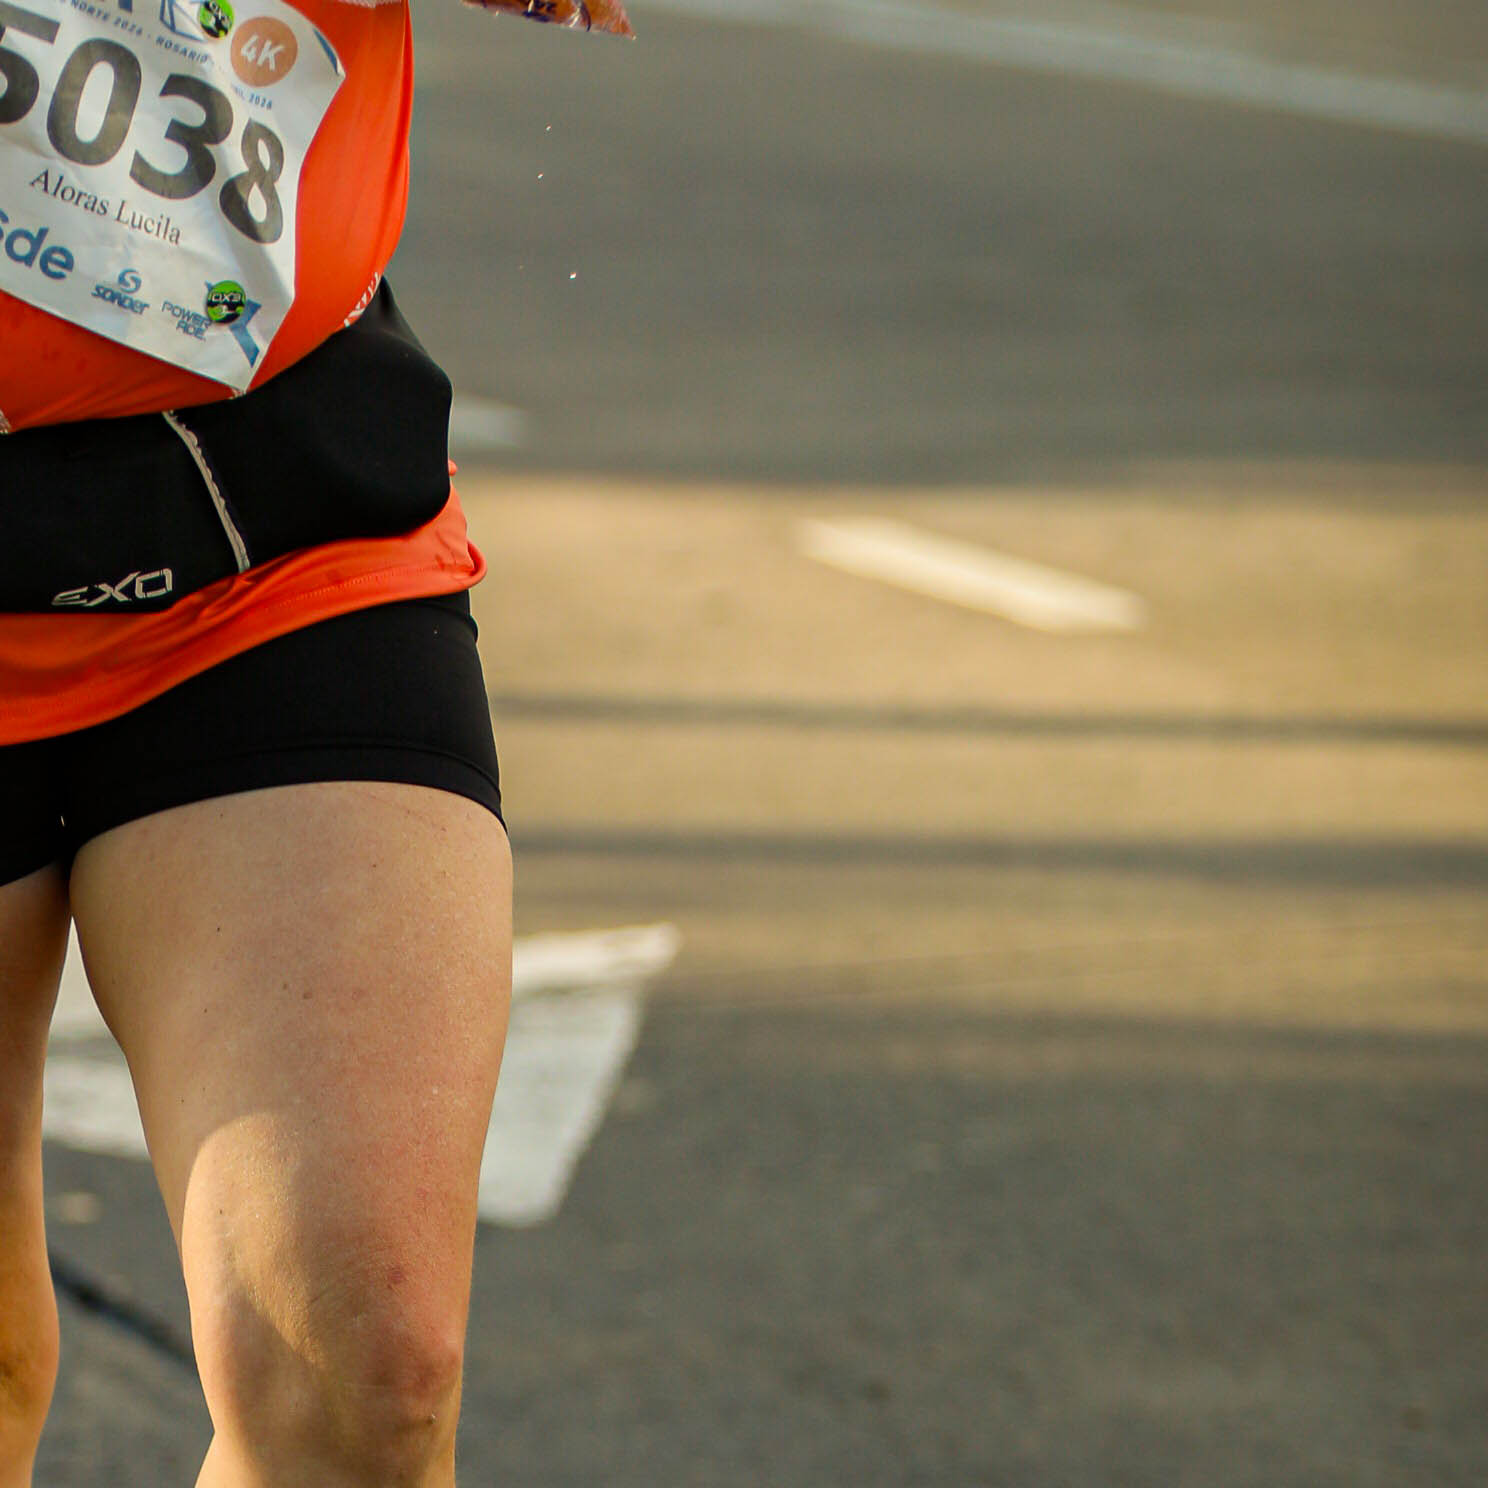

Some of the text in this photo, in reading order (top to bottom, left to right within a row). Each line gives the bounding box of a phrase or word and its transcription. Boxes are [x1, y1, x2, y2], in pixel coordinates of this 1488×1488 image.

[240, 34, 284, 72] 4K
[29, 168, 181, 245] Aloras Lucila
[162, 300, 212, 329] POWER
[52, 568, 172, 607] EXO
